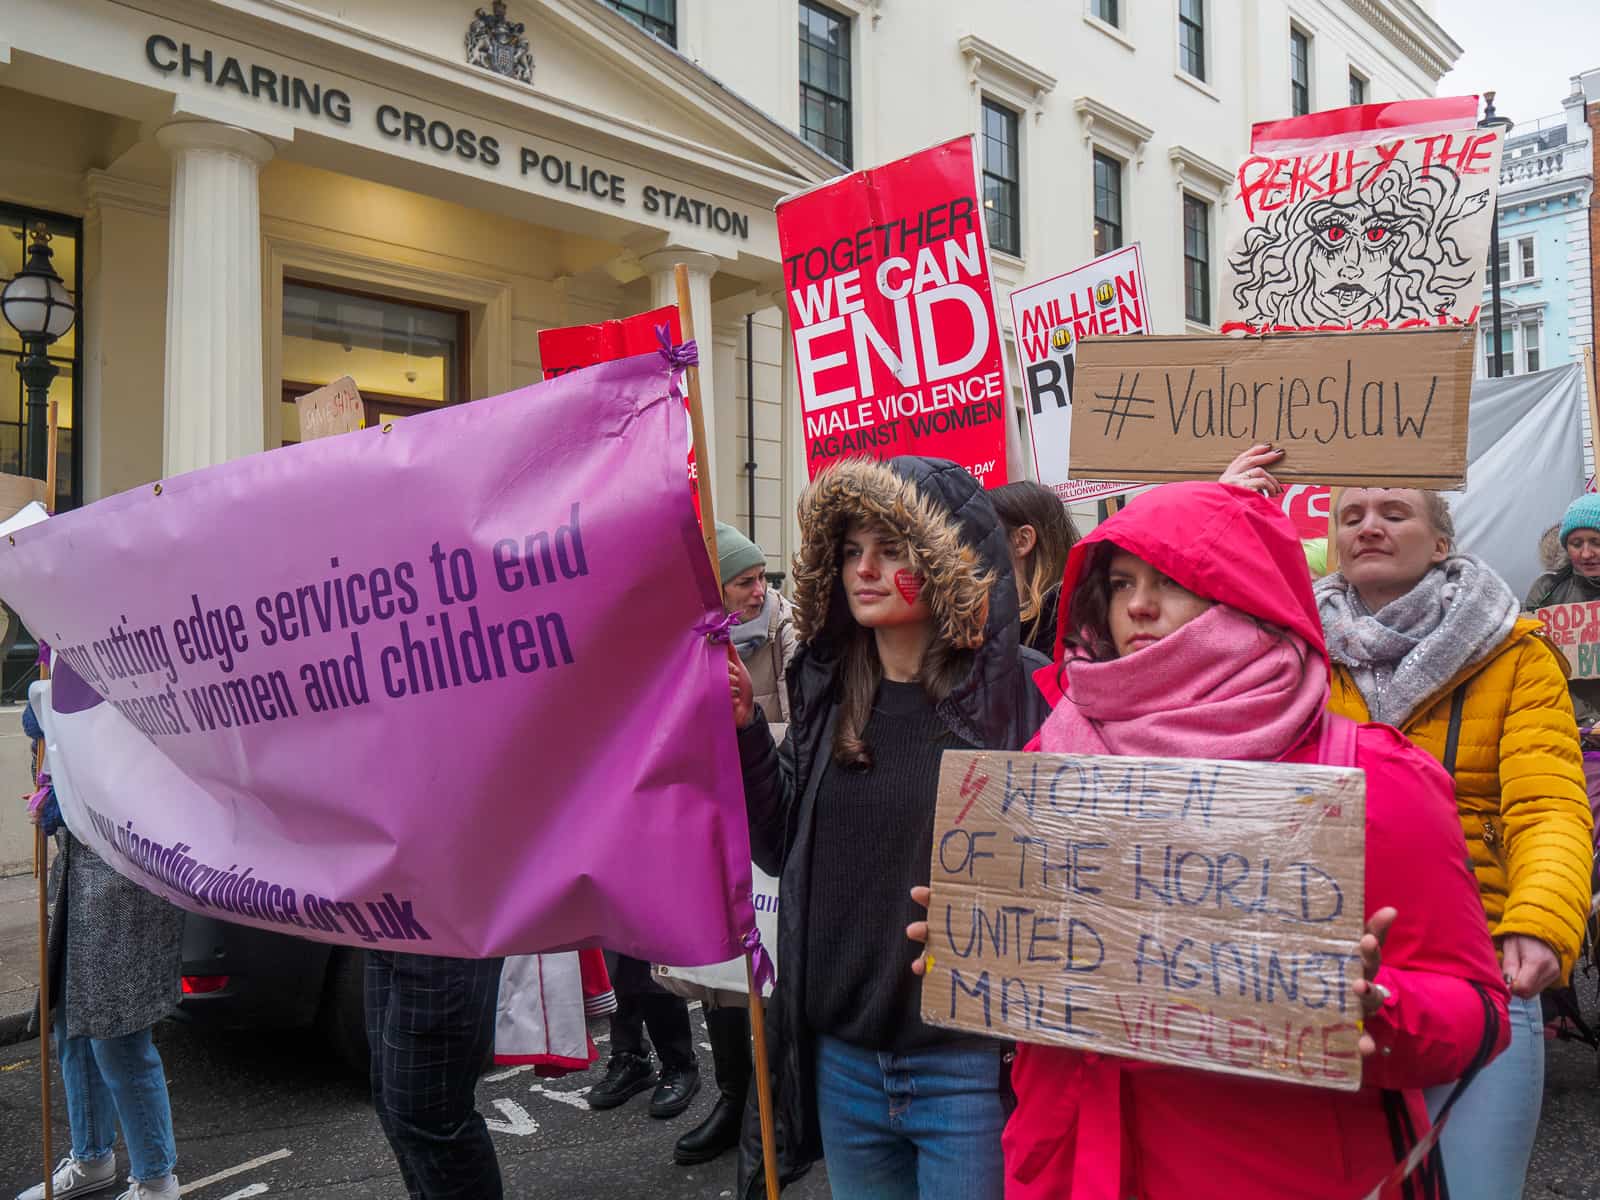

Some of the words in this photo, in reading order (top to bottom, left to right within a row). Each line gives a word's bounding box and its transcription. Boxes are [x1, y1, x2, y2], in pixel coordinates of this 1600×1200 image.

[145, 33, 351, 123] CHARING
[376, 104, 499, 166] CROSS
[520, 147, 626, 203] POLICE
[642, 185, 748, 239] STATION
[1414, 132, 1497, 183] THE
[785, 196, 974, 288] TOGETHER
[791, 269, 865, 327] WE
[876, 232, 982, 300] CAN
[794, 283, 990, 412] END
[806, 402, 875, 439] MALE
[878, 371, 1002, 421] VIOLENCE
[810, 420, 905, 461] AGAINST
[909, 398, 1002, 438] WOMEN
[974, 459, 996, 475] DAY
[92, 615, 179, 684] cutting
[173, 594, 249, 672] edge
[255, 556, 419, 646] services
[429, 541, 478, 605] to
[492, 502, 589, 592] end
[183, 668, 299, 732] women
[300, 631, 370, 713] and
[380, 605, 576, 698] children
[1001, 759, 1222, 828] WOMEN
[939, 828, 997, 879] OF
[1012, 834, 1109, 894] THE
[1134, 842, 1343, 923] WORLD
[945, 903, 1105, 973] UNITED
[1134, 932, 1361, 1013] AGAINST
[950, 968, 1100, 1037] MALE
[1114, 993, 1358, 1079] VIOLENCE
